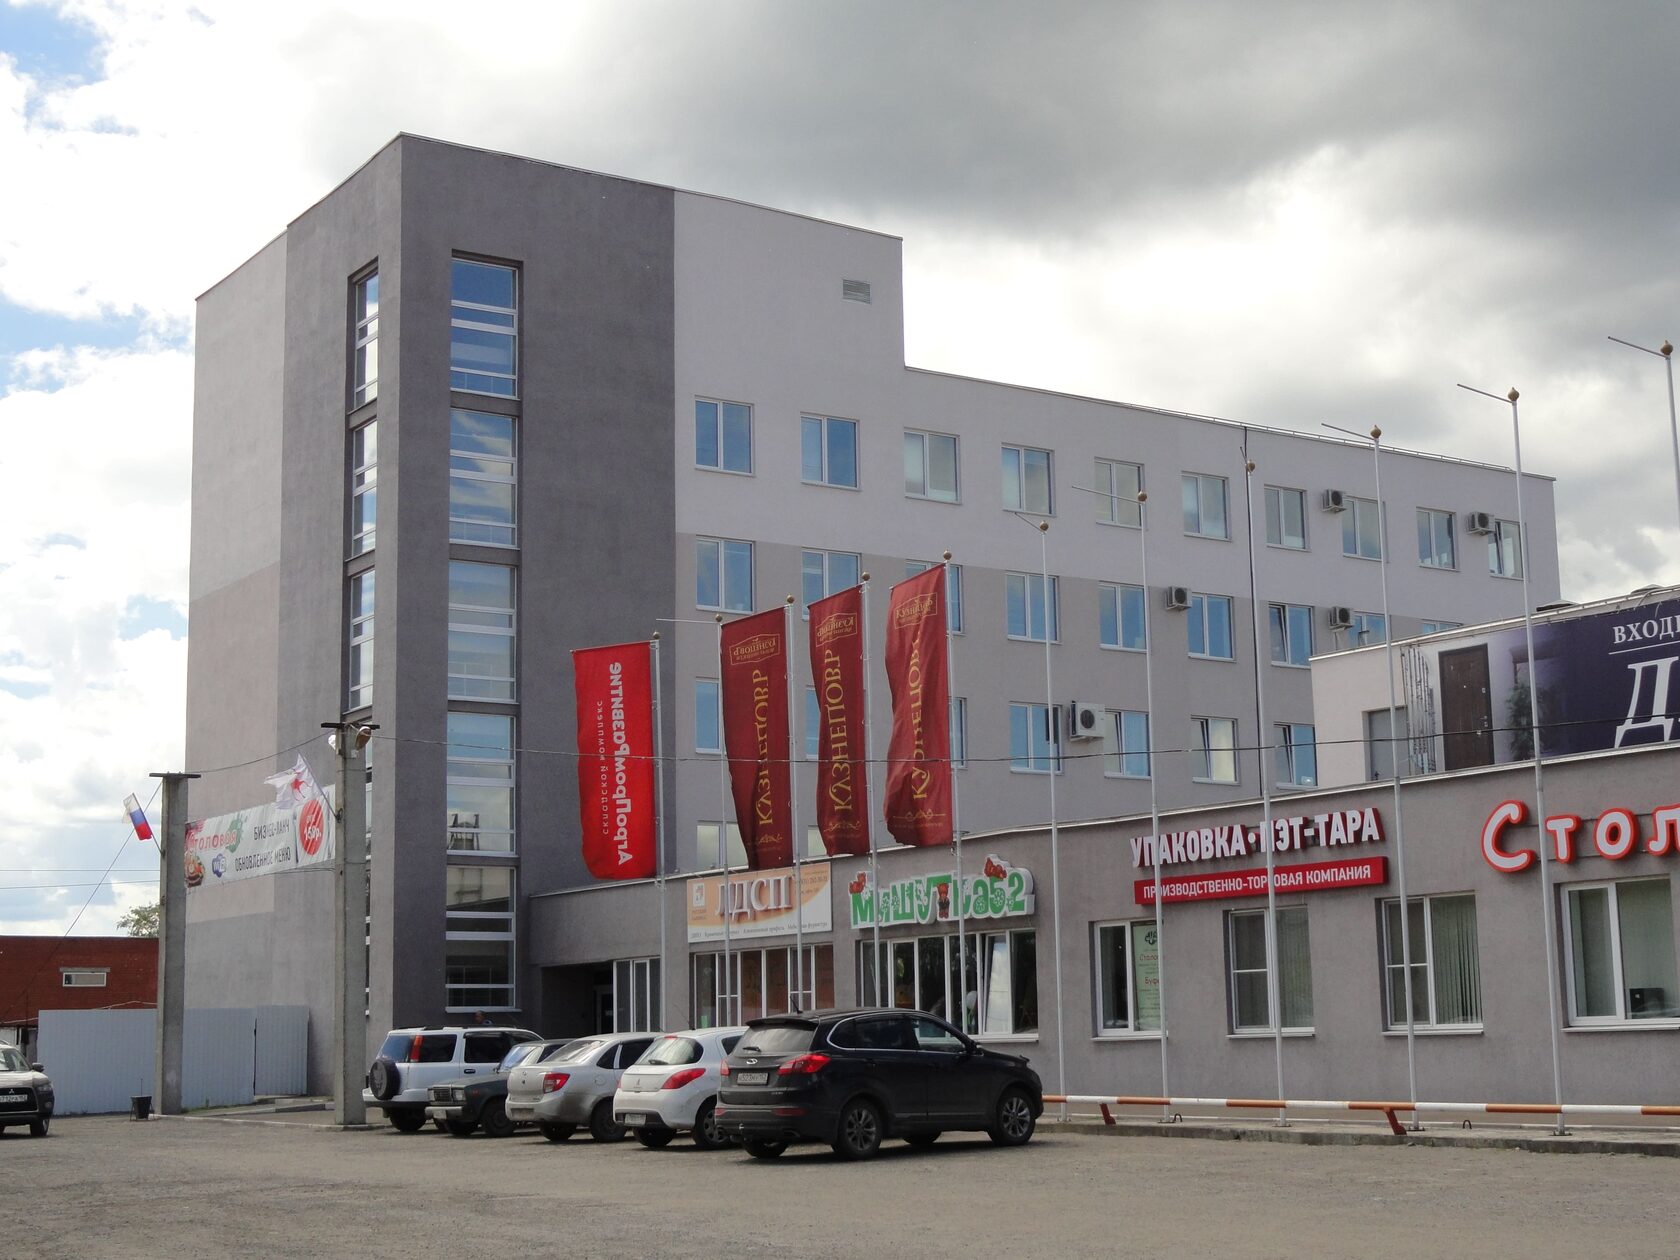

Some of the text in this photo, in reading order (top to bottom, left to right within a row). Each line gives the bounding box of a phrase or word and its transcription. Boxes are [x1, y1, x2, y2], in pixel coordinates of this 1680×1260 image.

[715, 875, 792, 921] ЛДСП
[1143, 865, 1371, 899] ПРИЗВОДСТВЕННО-ТОРОВАЯ КОМПАНИЯ
